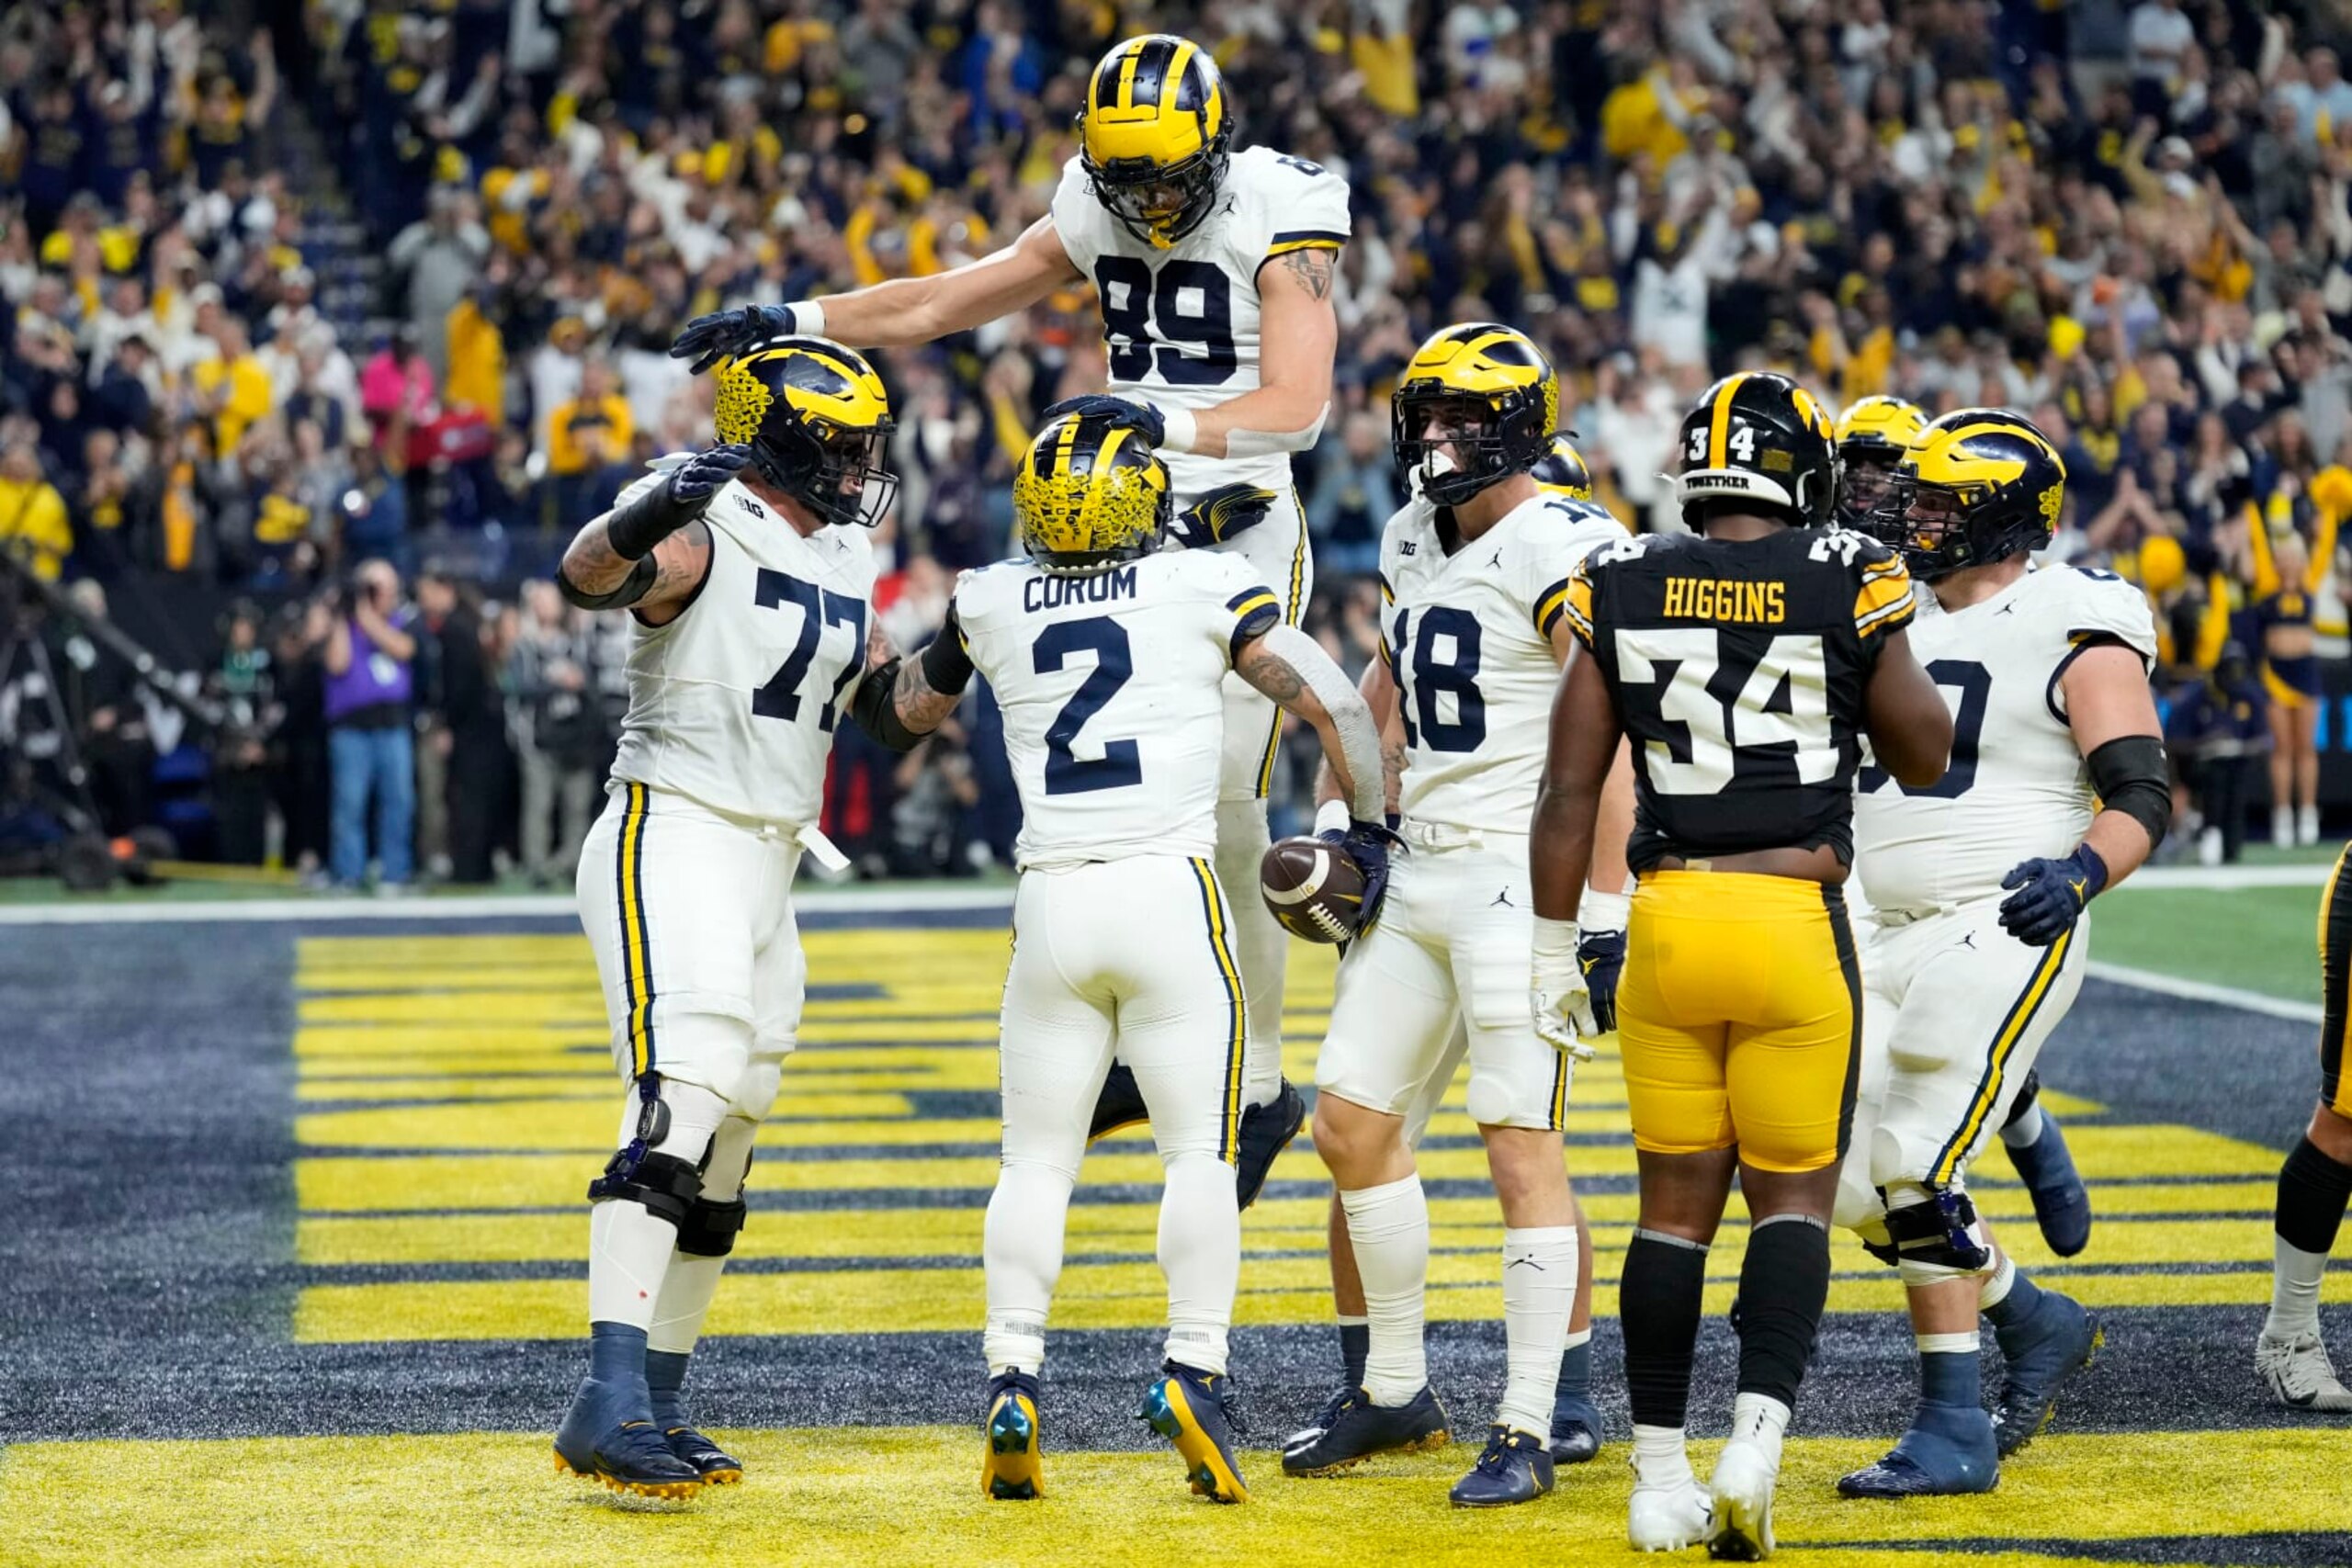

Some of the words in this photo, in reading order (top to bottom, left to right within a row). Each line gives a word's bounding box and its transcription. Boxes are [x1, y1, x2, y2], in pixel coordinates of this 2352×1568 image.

[1093, 254, 1238, 386] 89
[752, 567, 866, 733] 77
[1024, 566, 1137, 614] CORUM
[1663, 577, 1787, 624] HIGGINS
[1033, 615, 1143, 796] 2
[1389, 605, 1487, 753] 18
[1614, 627, 1839, 795] 34
[1858, 659, 1993, 799] 0
